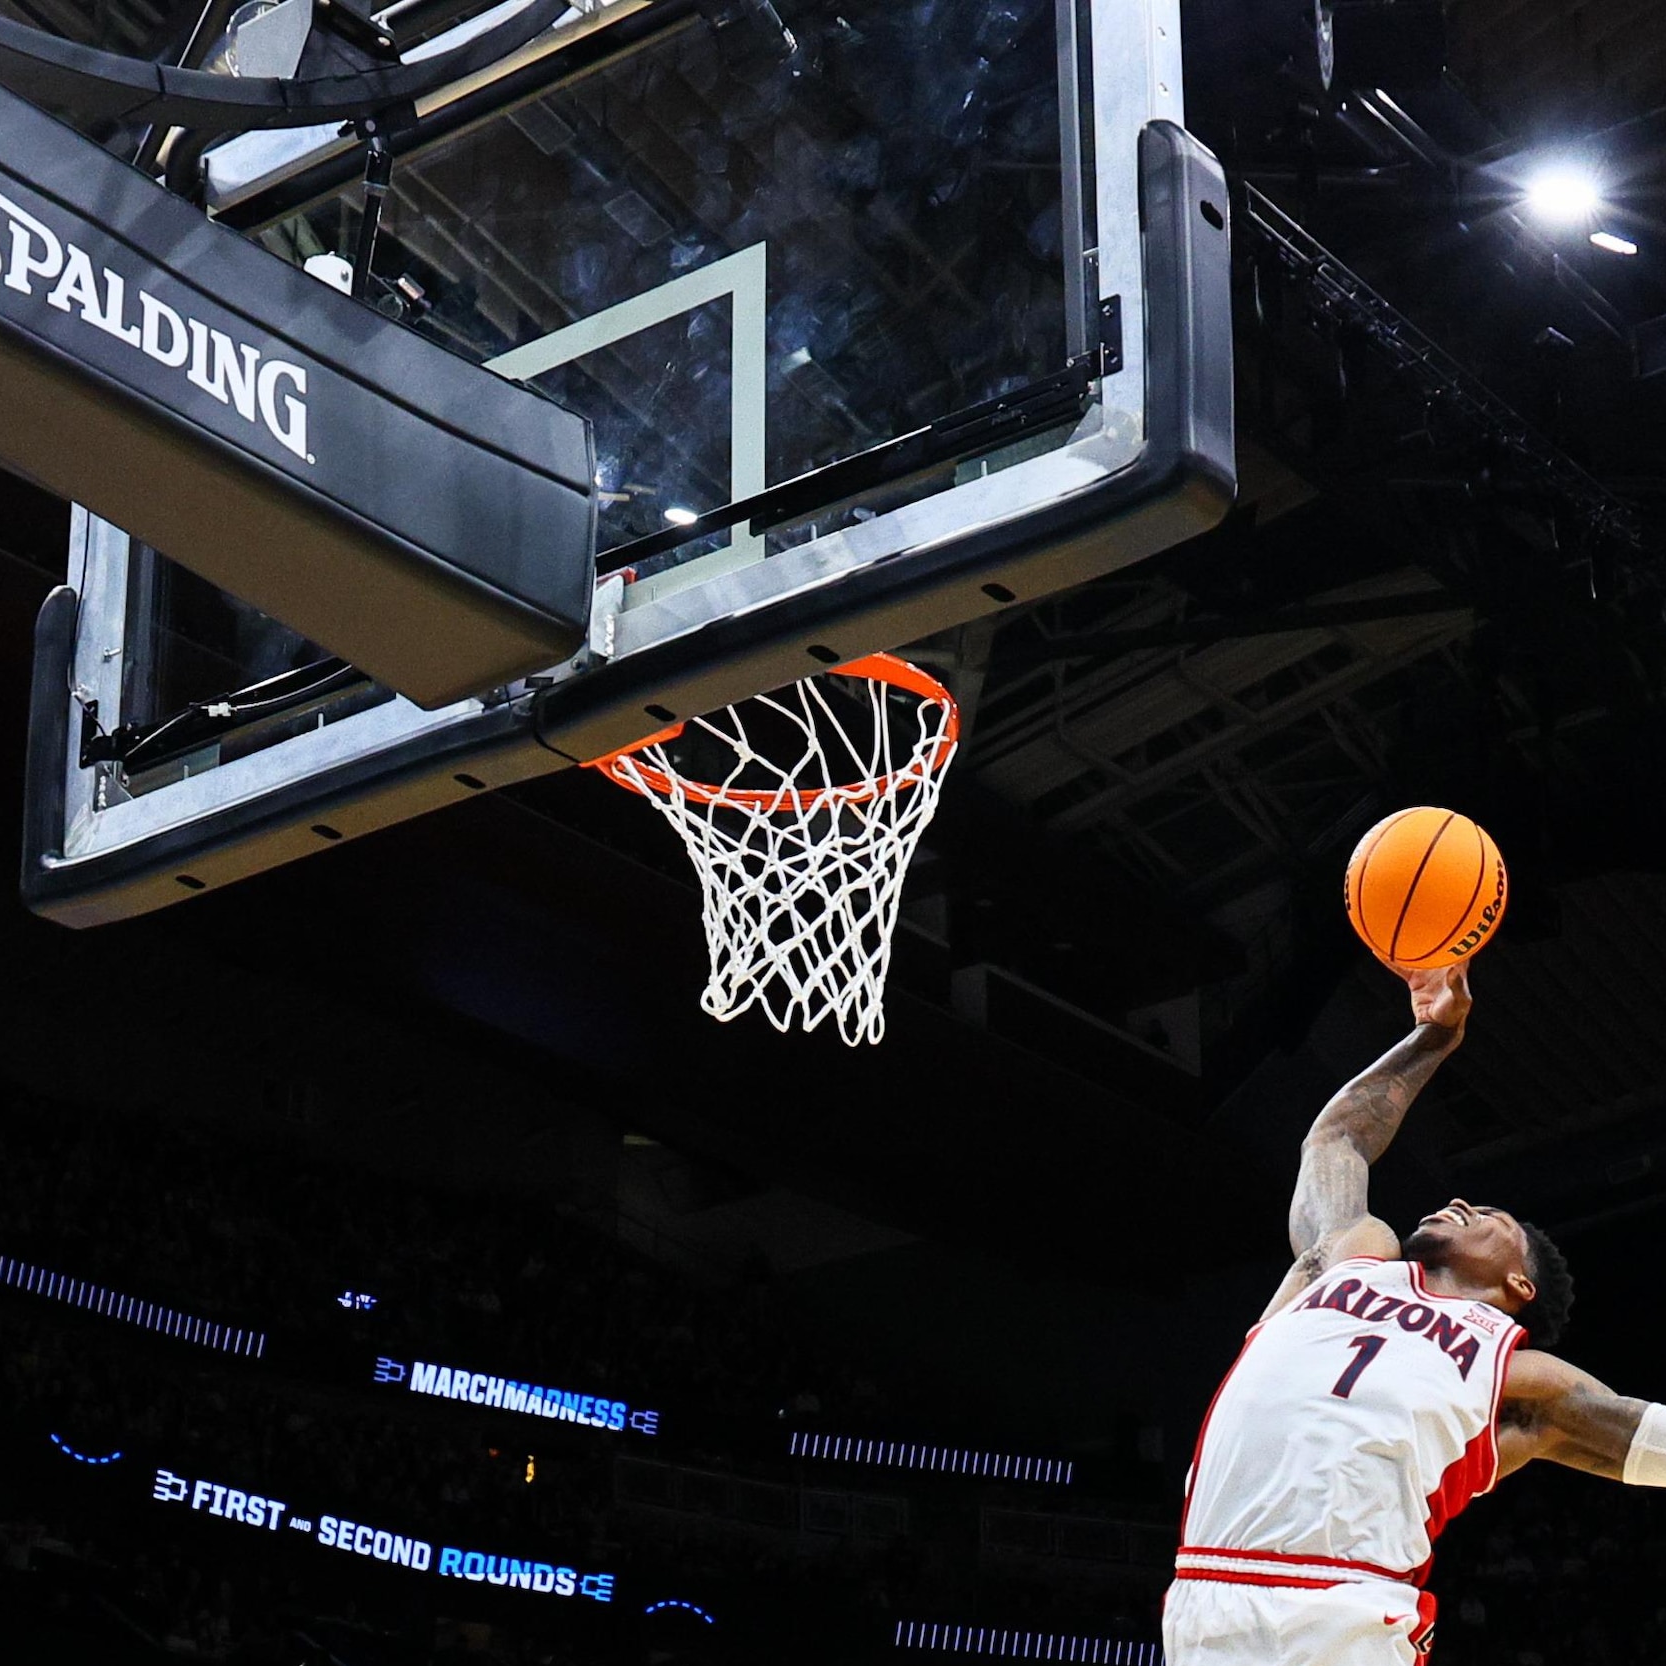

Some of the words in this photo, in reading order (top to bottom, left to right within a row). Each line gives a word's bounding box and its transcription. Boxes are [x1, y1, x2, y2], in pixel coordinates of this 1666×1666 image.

[1448, 859, 1506, 957] Wilson
[1298, 1278, 1481, 1382] ARIZONA
[1331, 1335, 1388, 1399] 1
[409, 1361, 627, 1431] MARCHMADNESS
[191, 1479, 286, 1531] FIRST
[289, 1517, 312, 1532] AND
[318, 1516, 432, 1572] SECOND
[439, 1547, 577, 1597] ROUNDS
